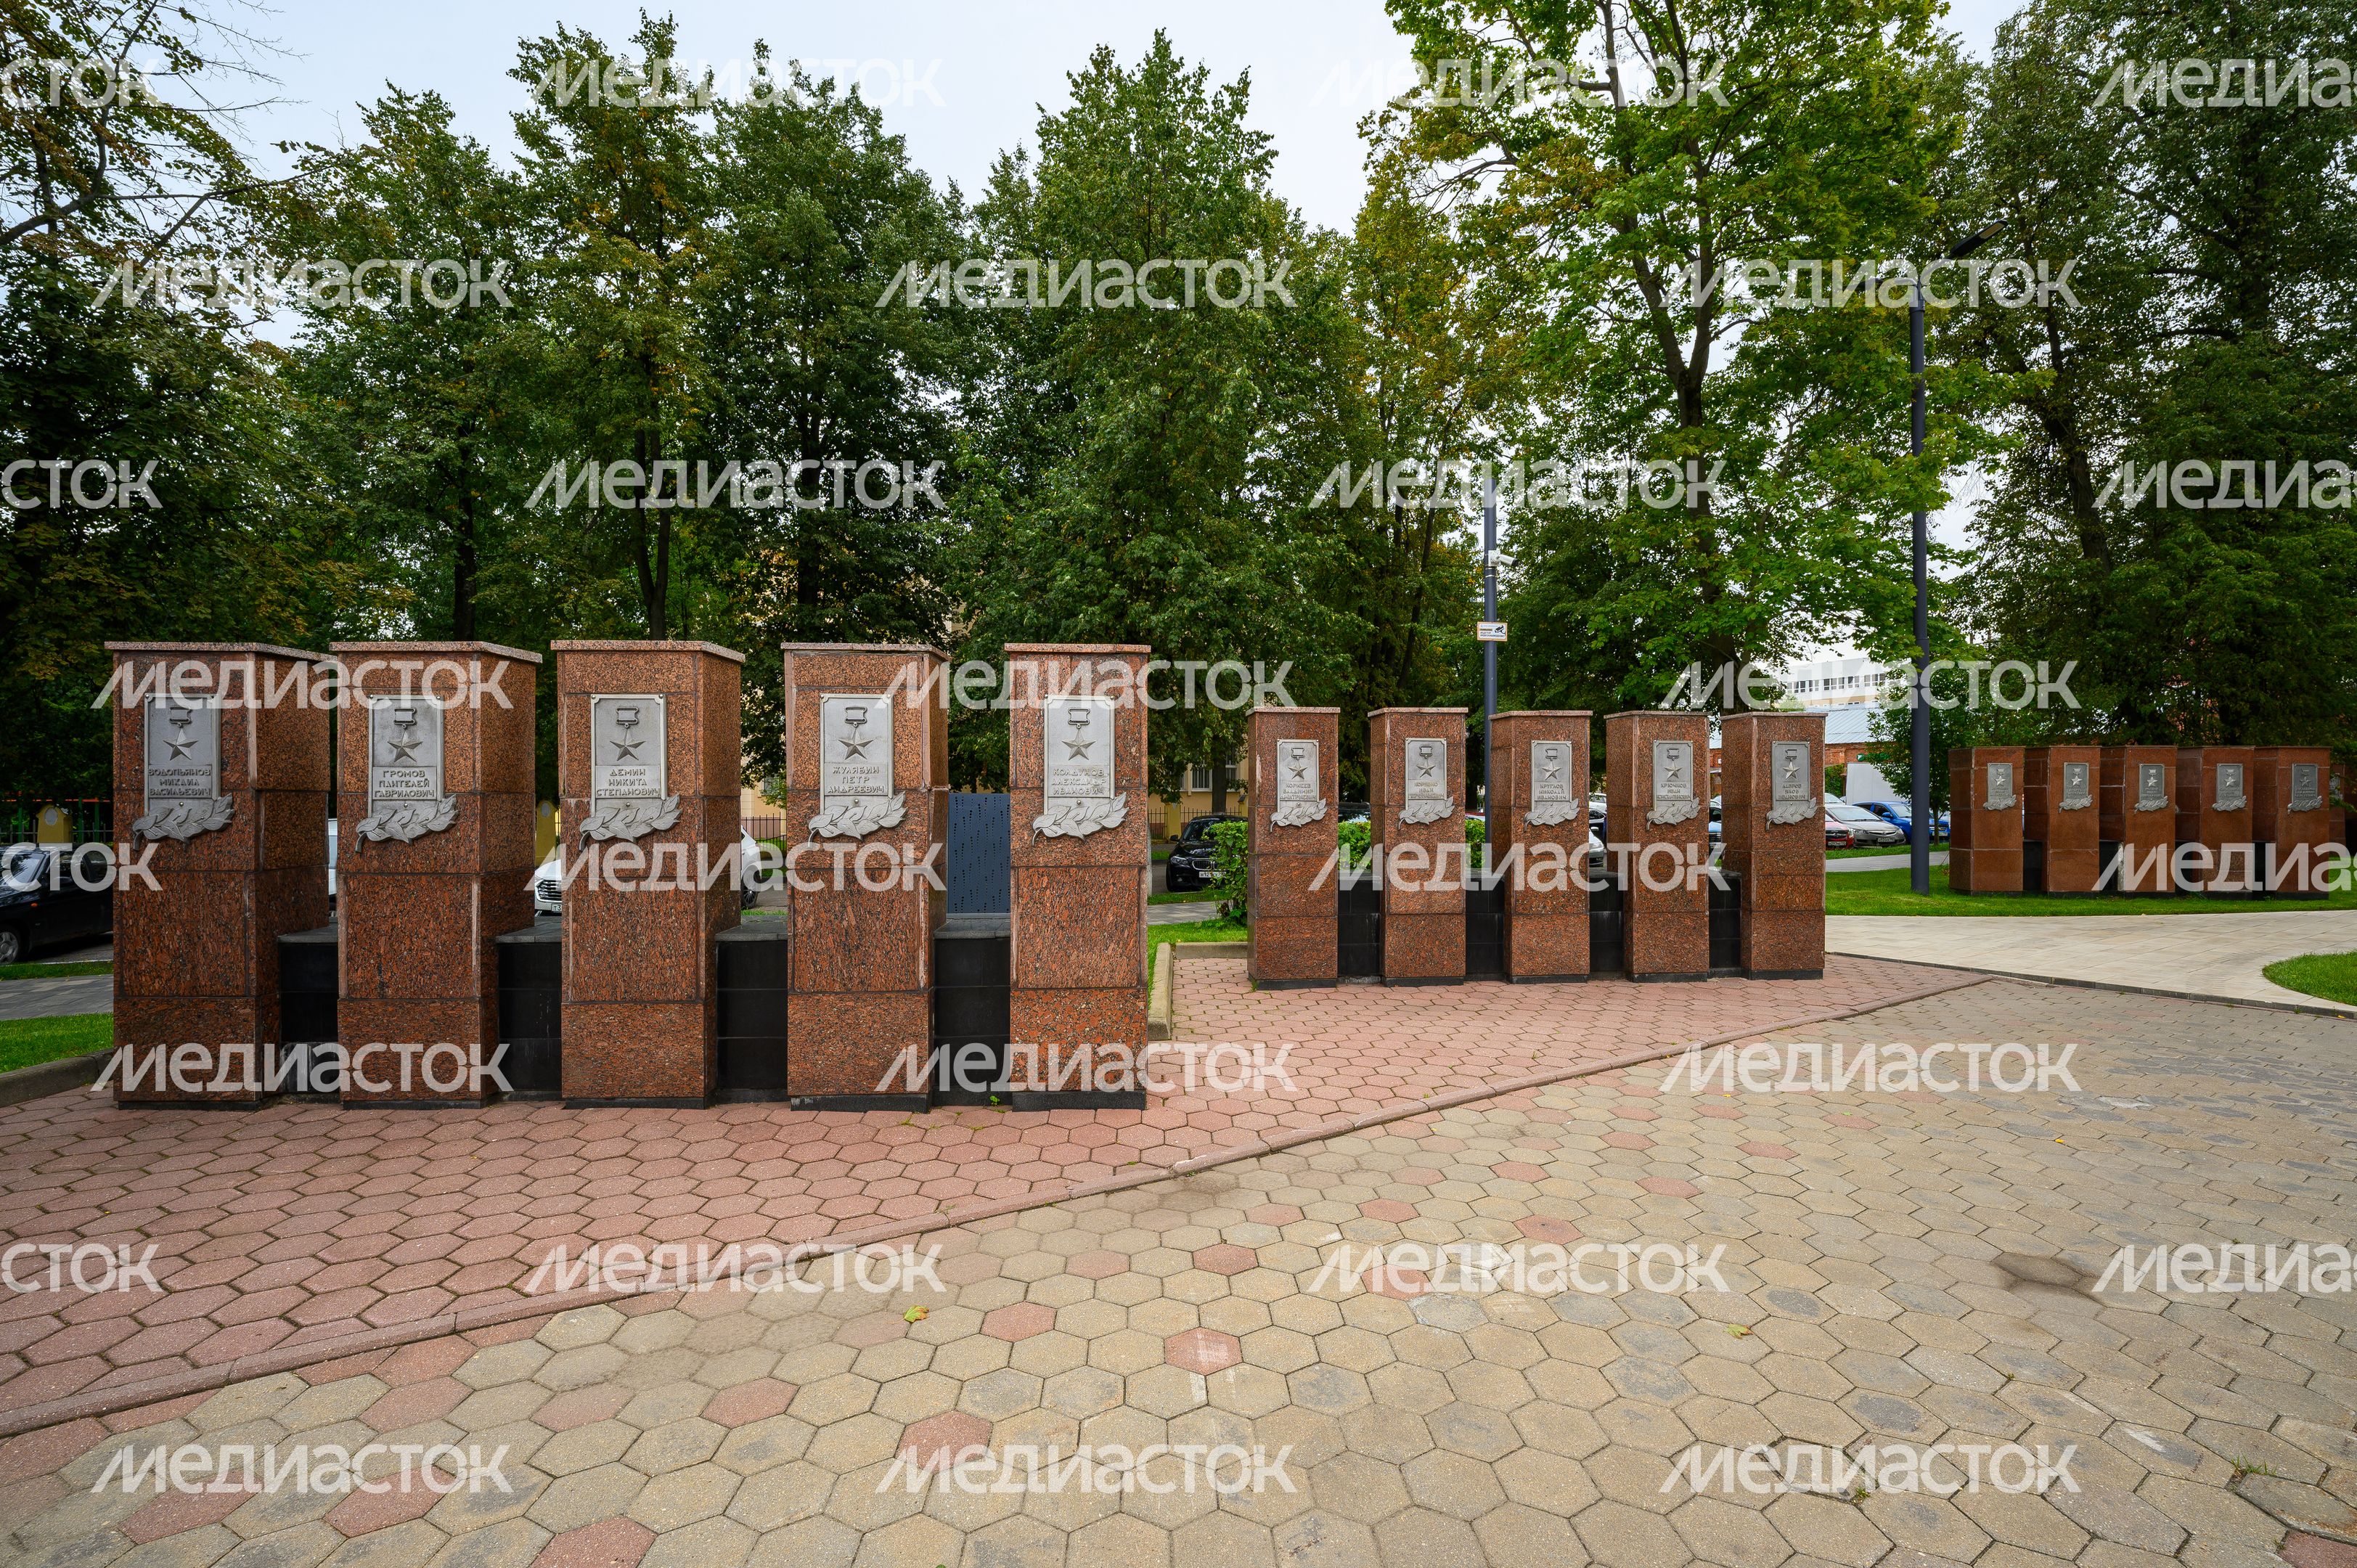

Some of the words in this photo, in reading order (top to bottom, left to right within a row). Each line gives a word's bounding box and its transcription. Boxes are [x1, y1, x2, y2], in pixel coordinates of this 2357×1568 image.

[833, 766, 879, 775] ЖУЛЯБИН
[379, 777, 430, 788] ПАНТЕЛЕЙ
[842, 775, 870, 784] ПЕТР
[375, 789, 435, 798] ГАВРИЛОВИЧ
[596, 788, 661, 797] СТЕПАНОВИЧ
[828, 785, 885, 793] АНДРЕЕВИЧ
[1053, 787, 1105, 796] ИВАНОВИЧ
